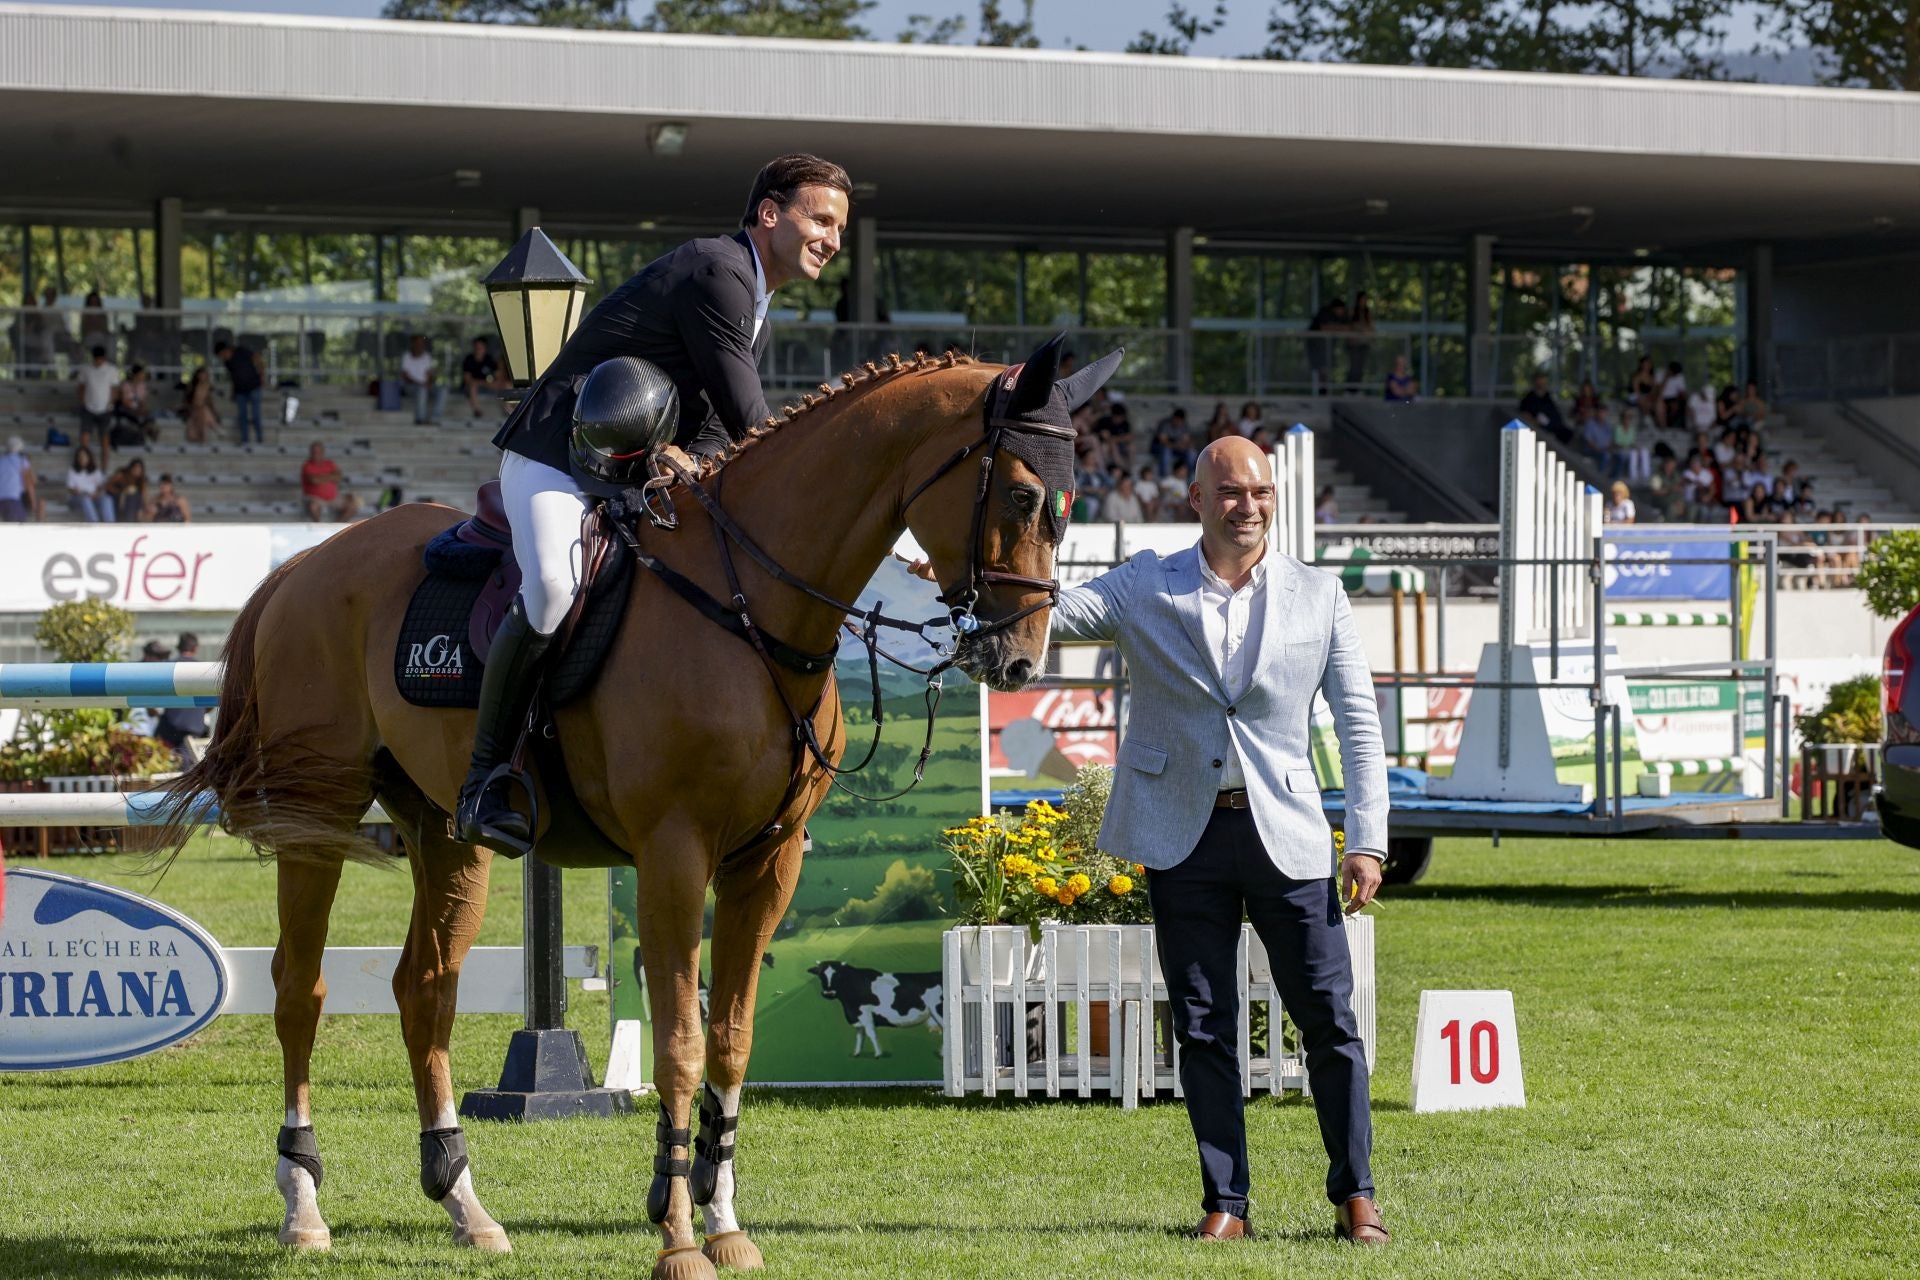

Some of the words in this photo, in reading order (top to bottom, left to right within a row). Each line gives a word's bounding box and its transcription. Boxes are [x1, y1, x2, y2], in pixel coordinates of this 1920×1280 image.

[42, 535, 213, 602] esfer
[1618, 550, 1673, 577] COPE
[406, 634, 464, 668] RGA
[1440, 1019, 1500, 1085] 10
